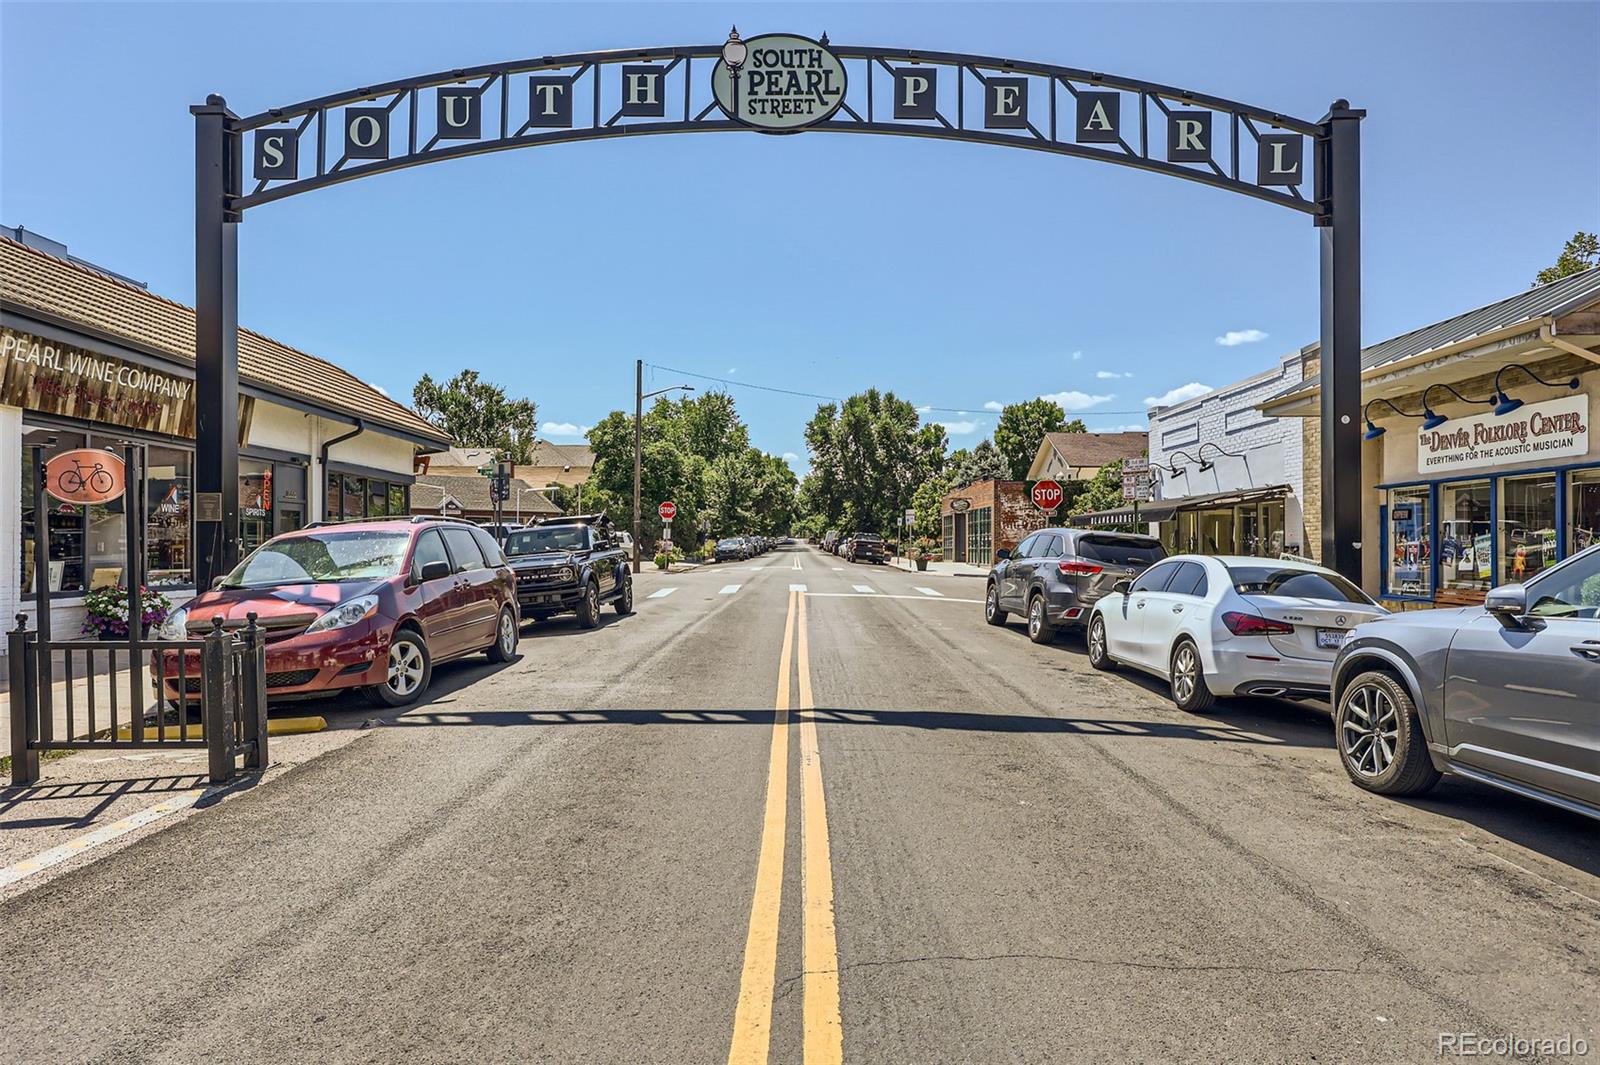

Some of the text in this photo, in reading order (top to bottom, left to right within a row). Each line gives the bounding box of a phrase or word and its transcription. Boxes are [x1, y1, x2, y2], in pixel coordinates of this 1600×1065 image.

[753, 48, 823, 68] SOUTH
[747, 70, 840, 106] PEARL
[748, 98, 816, 118] STREET
[262, 73, 1298, 174] SOUTH PEARL
[2, 337, 64, 371] PEARL
[70, 352, 116, 383] WINE
[117, 366, 192, 400] COMPANY
[1426, 438, 1574, 466] EVERYTHING FOR THE ACOUSTIC MUSICIAN
[263, 469, 272, 511] OPEN
[1034, 489, 1061, 500] STOP
[161, 504, 180, 513] WINE
[245, 508, 266, 517] SPIRITS
[660, 506, 675, 514] STOP
